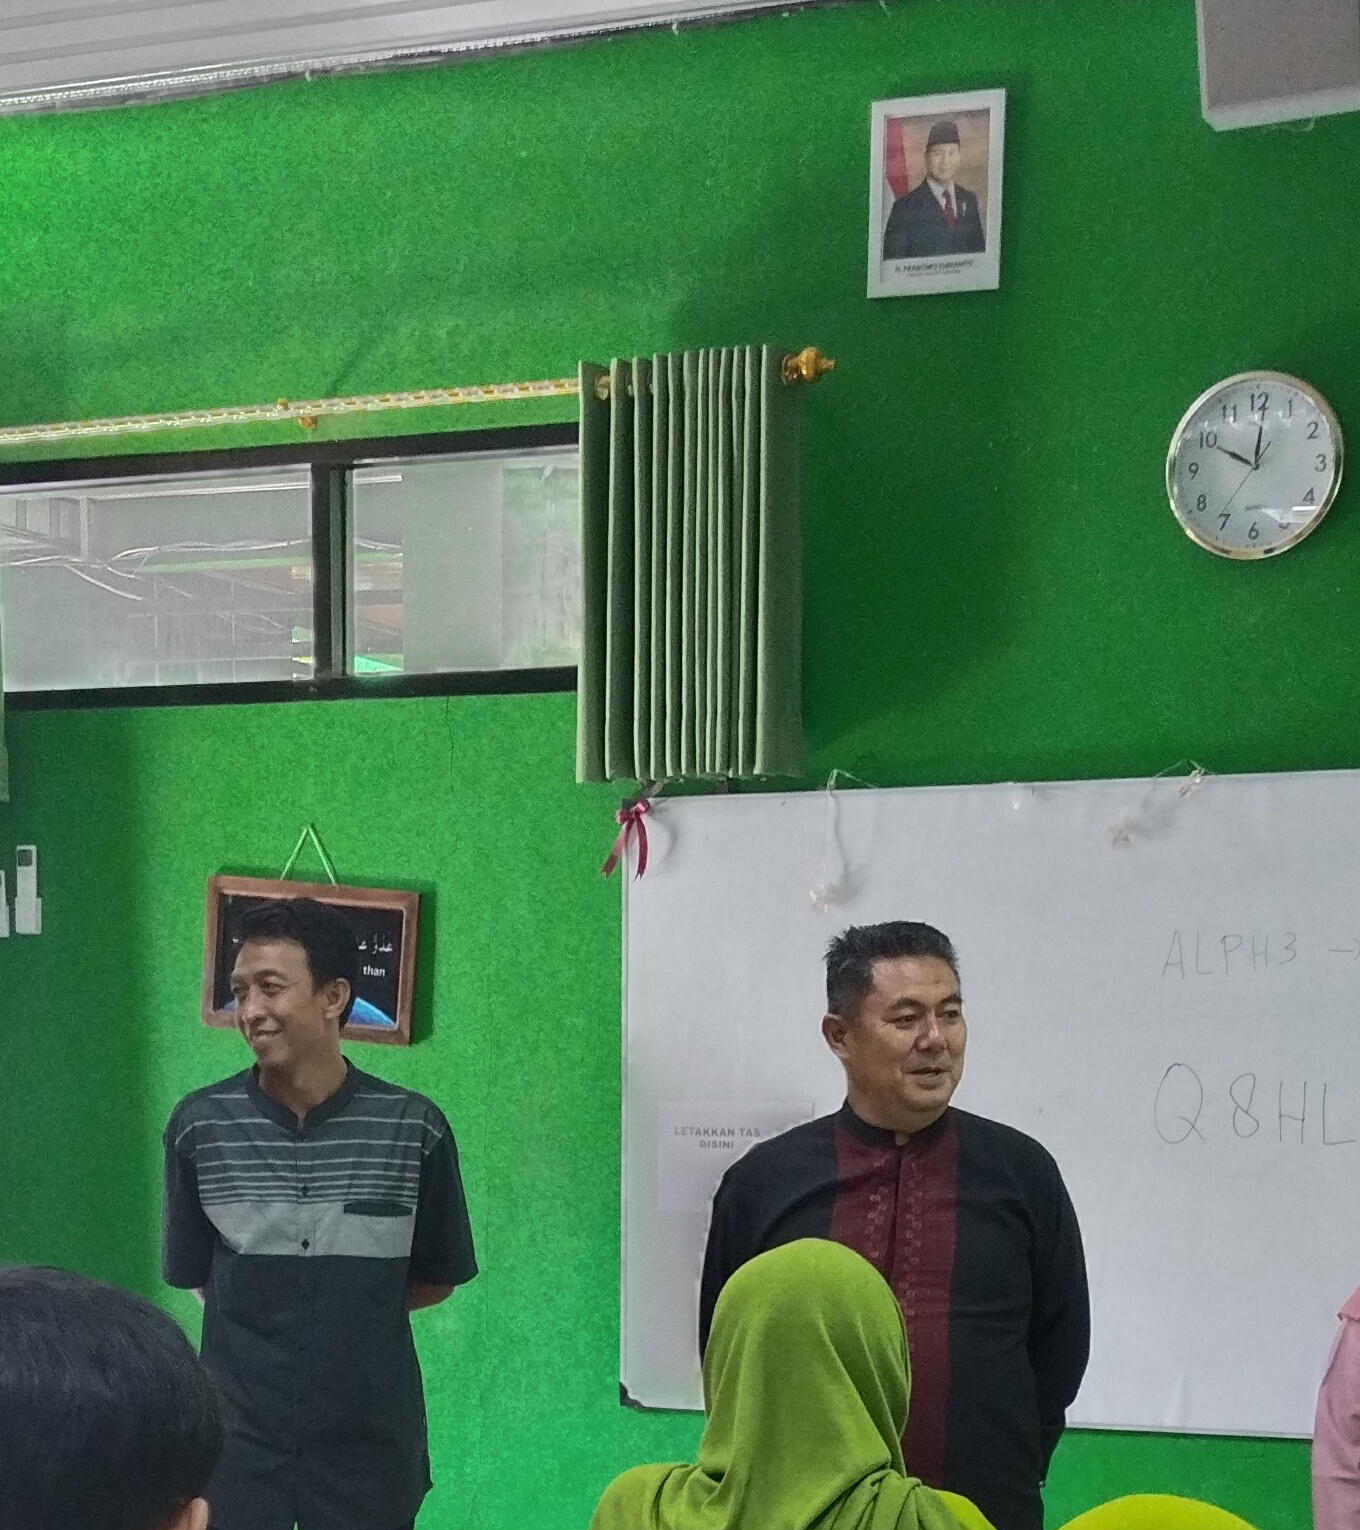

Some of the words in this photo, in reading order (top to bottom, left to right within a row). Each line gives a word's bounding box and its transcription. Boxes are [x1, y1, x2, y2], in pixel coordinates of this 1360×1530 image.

[1249, 392, 1269, 413] 12
[1222, 403, 1237, 423] 11
[1306, 421, 1319, 440] 2
[1199, 431, 1218, 449] 10
[1188, 462, 1199, 481] 9
[1314, 454, 1327, 472] 3
[1196, 494, 1207, 512] 8
[1302, 487, 1315, 504] 4
[1218, 513, 1231, 531] 7
[1248, 522, 1259, 540] 6
[363, 964, 386, 978] than
[674, 1126, 735, 1137] LETAKKAN
[739, 1127, 761, 1138] TAS
[699, 1140, 735, 1149] DISINI
